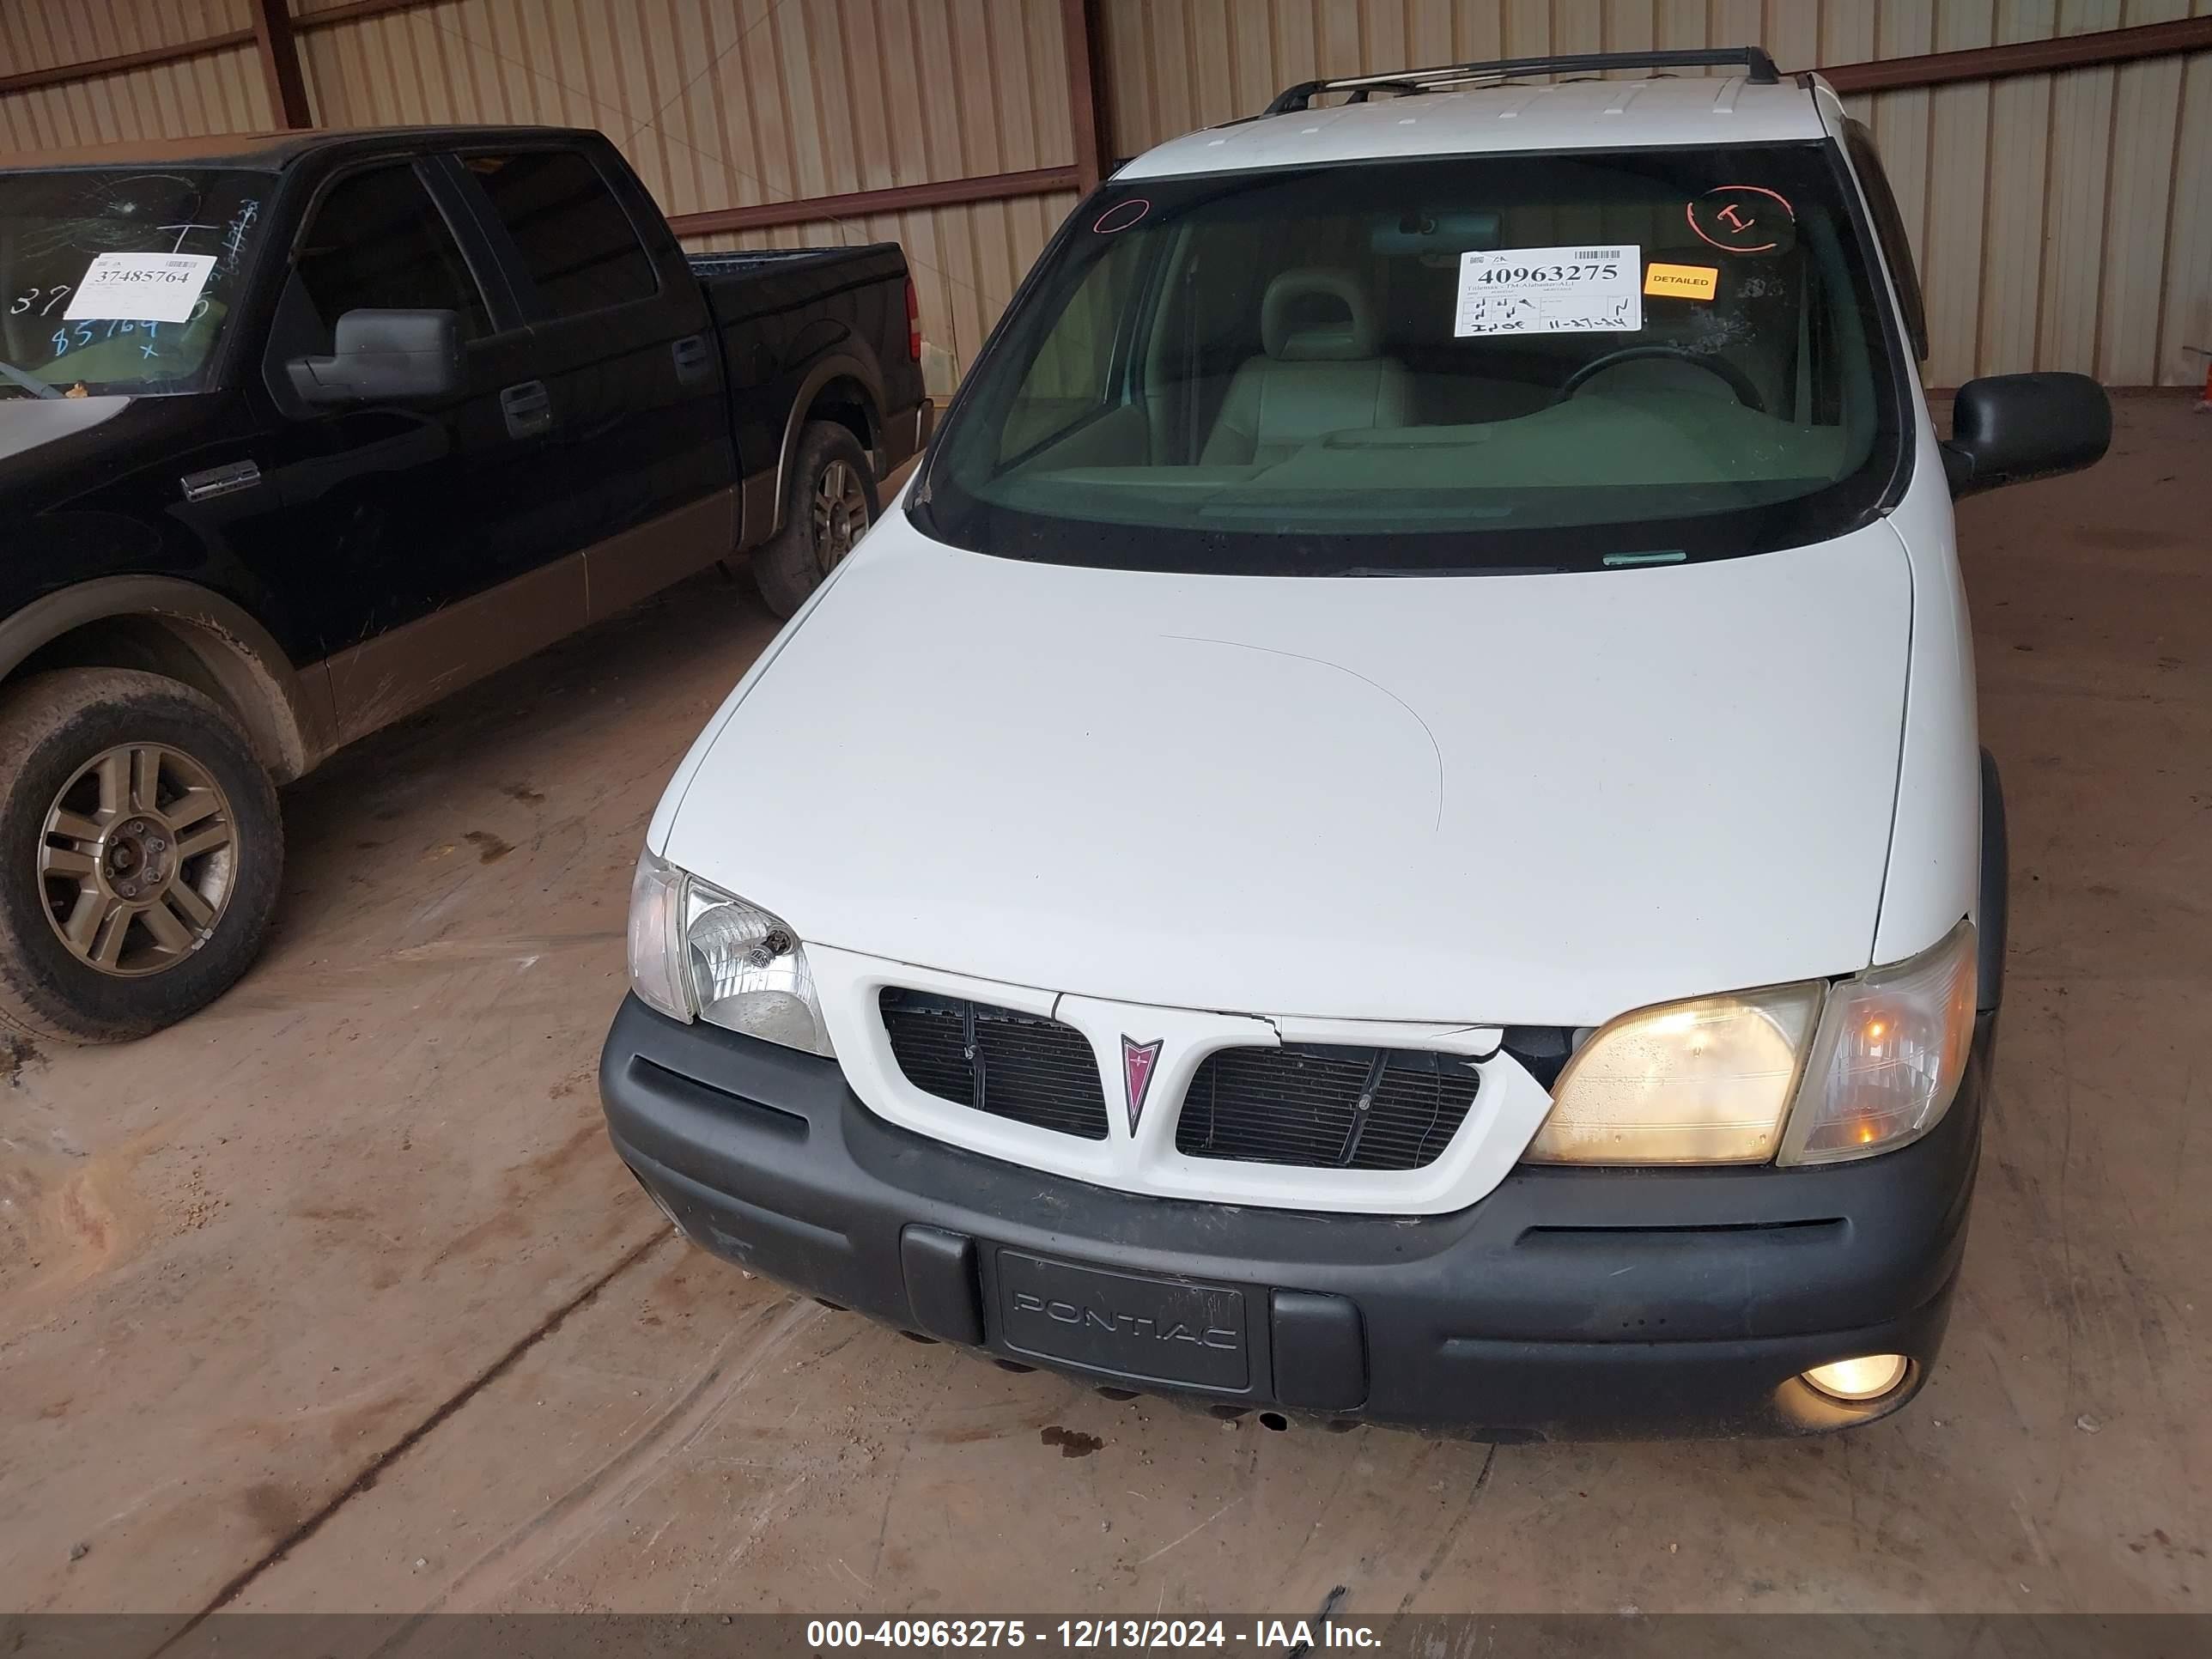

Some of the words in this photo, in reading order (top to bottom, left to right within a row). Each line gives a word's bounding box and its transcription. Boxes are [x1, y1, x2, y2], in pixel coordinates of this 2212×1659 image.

[94, 270, 191, 283] 37485764
[1477, 264, 1619, 284] 40963275
[1653, 275, 1709, 286] DETAILED
[1012, 1291, 1238, 1351] PONTIAC
